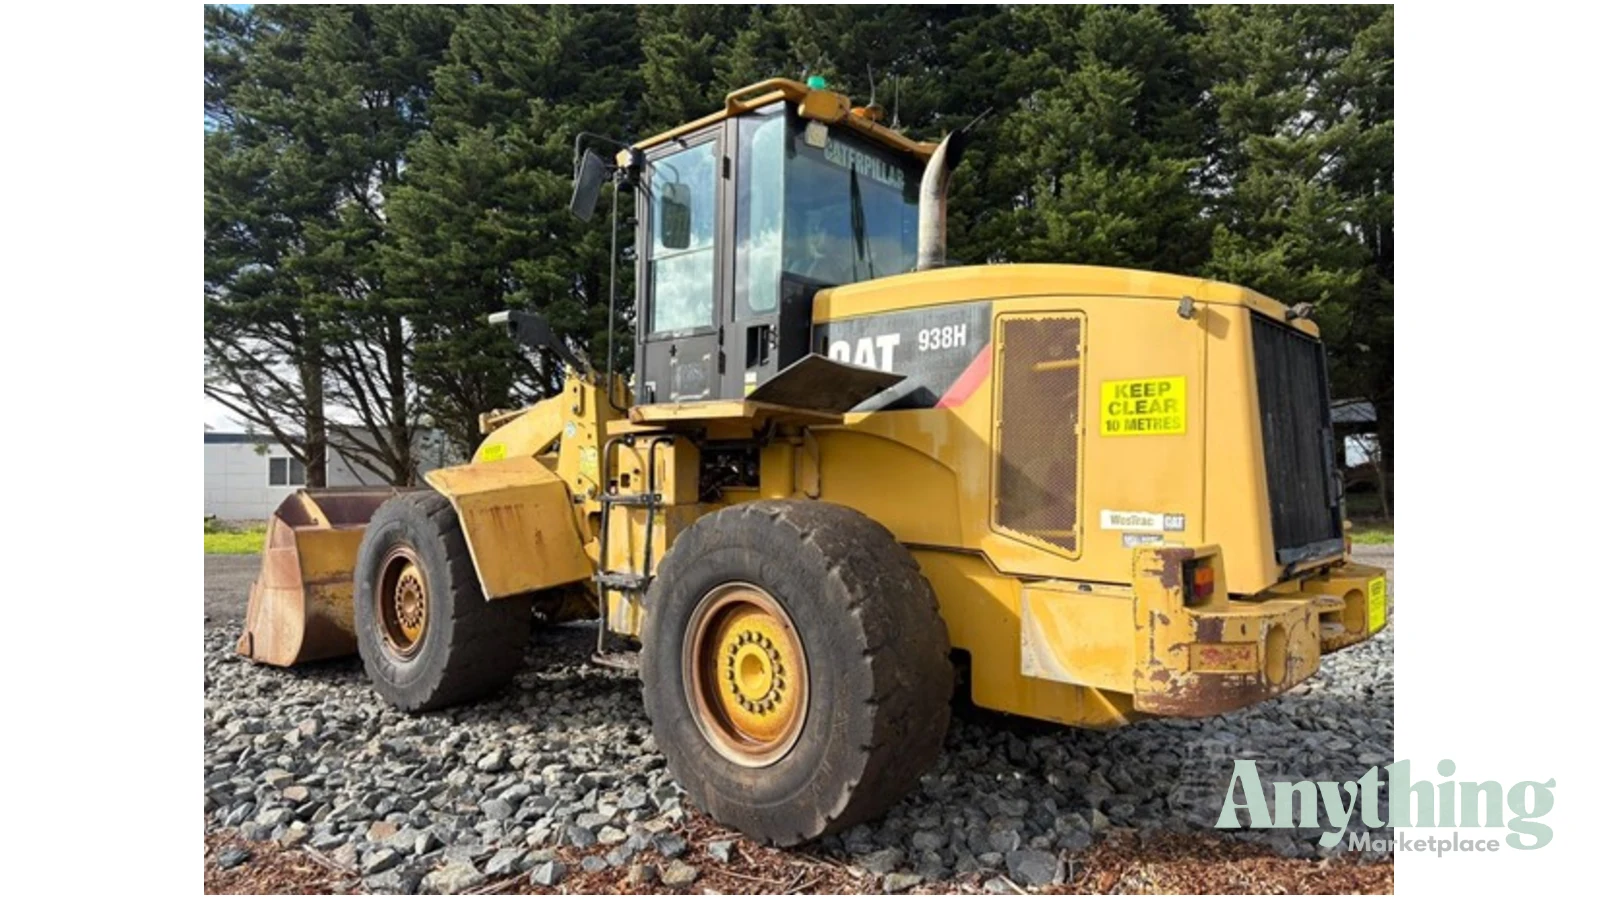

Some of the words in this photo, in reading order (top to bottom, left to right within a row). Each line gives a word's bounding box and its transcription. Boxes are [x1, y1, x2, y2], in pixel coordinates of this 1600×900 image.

[824, 138, 904, 188] CATERPILLAR
[918, 324, 967, 351] 938H
[1114, 381, 1171, 399] KEEP
[1108, 398, 1178, 416] CLEAR
[1106, 419, 1120, 432] 10
[1124, 416, 1181, 432] METRES
